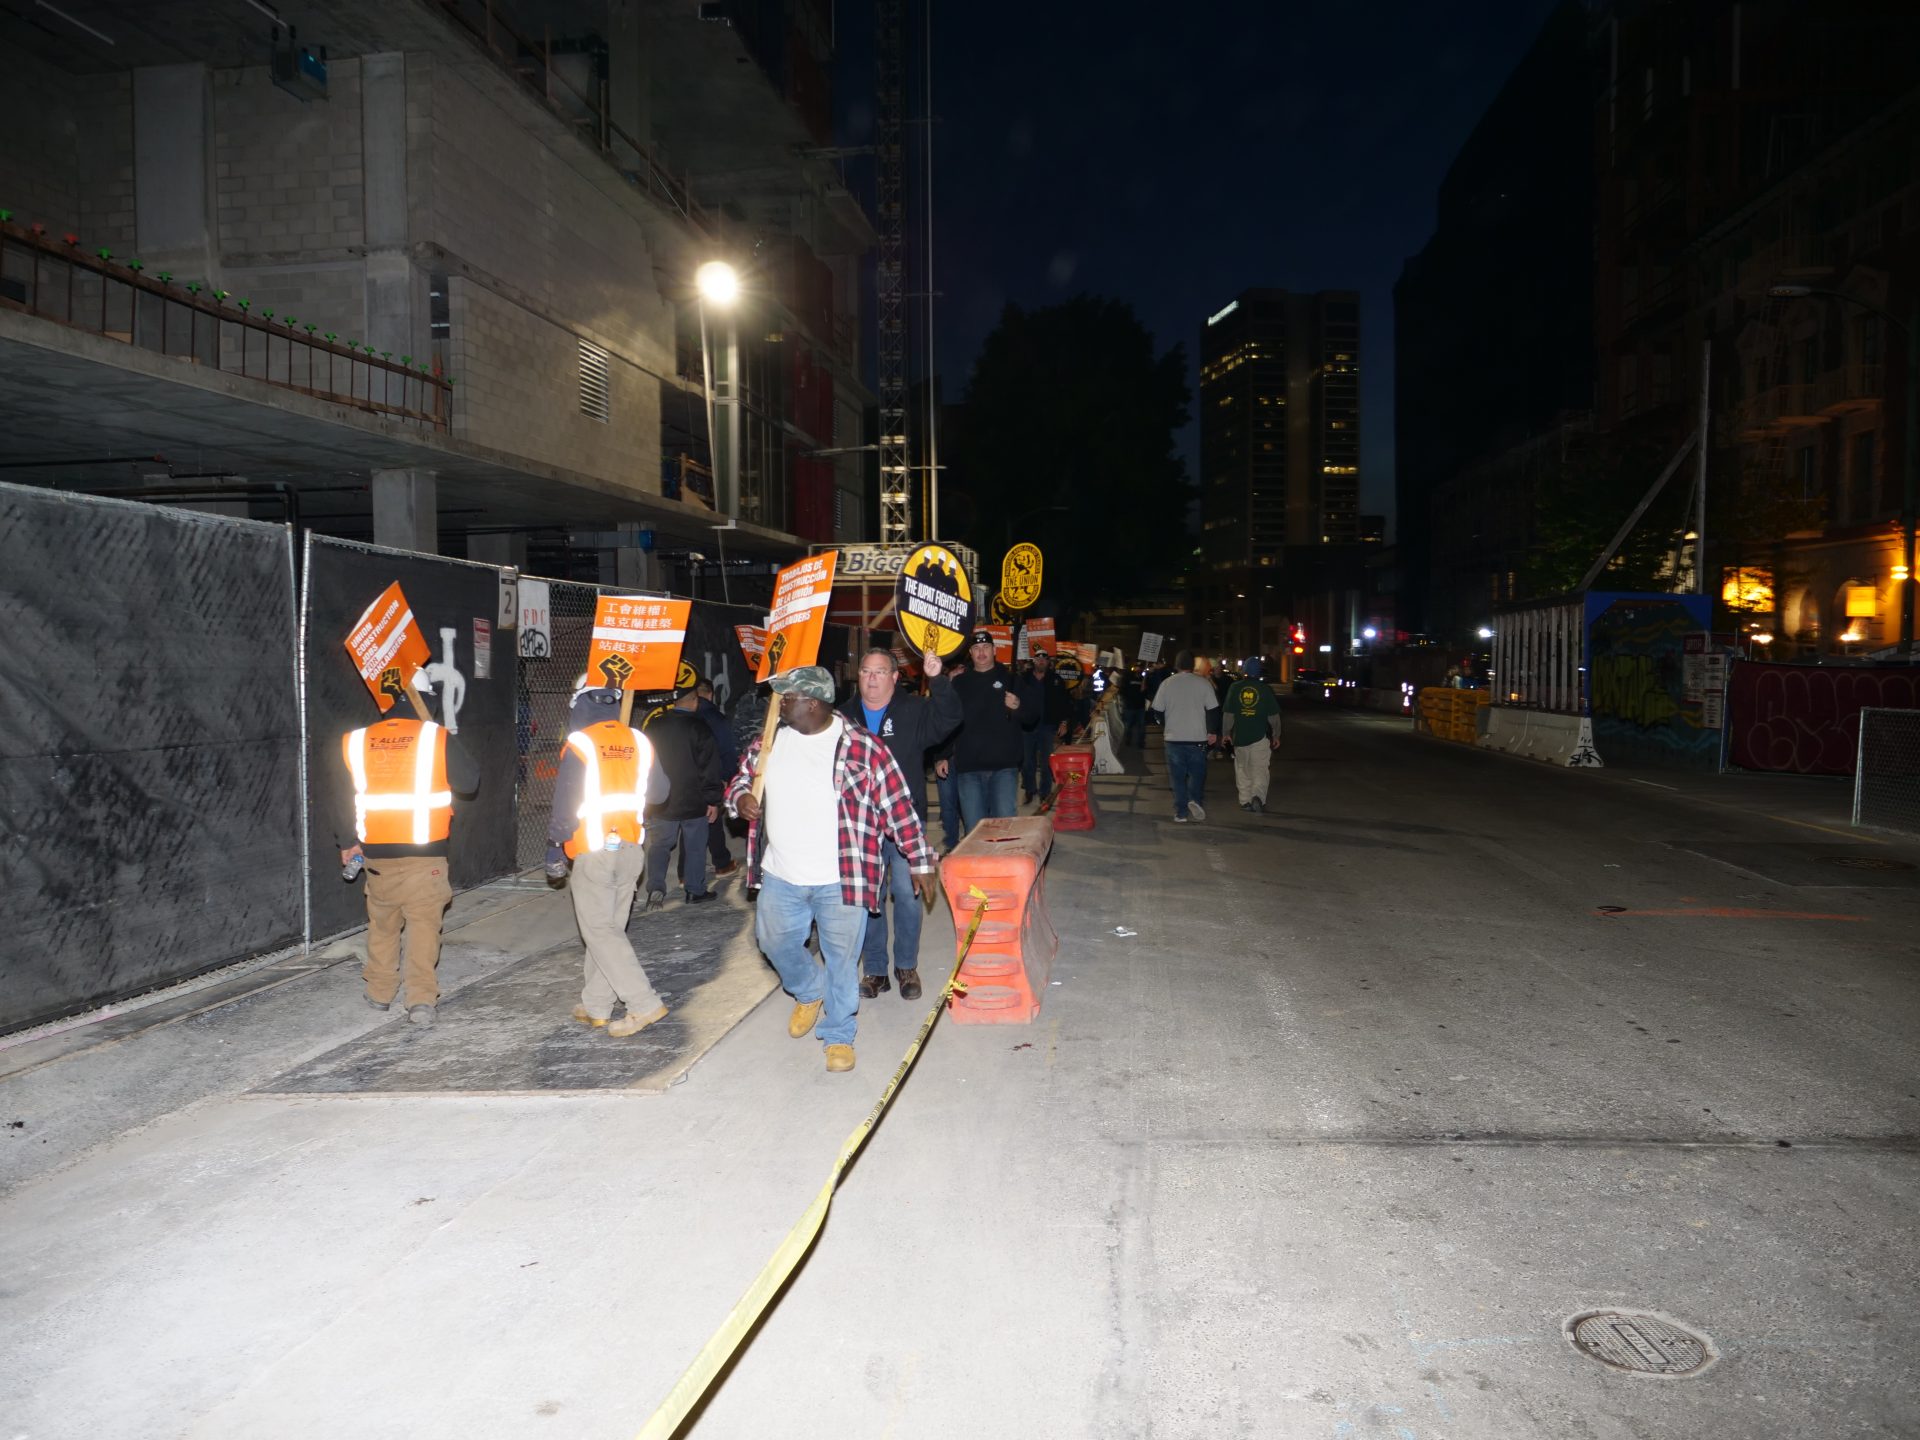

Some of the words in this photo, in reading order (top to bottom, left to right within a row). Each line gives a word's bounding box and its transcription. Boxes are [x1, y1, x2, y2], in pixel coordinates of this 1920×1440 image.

[813, 559, 824, 571] DE
[848, 552, 902, 572] BIGG
[1005, 577, 1017, 587] ONE
[1019, 575, 1039, 586] UNION
[504, 591, 512, 615] 2
[905, 576, 918, 596] THE
[917, 582, 936, 603] IUPAT
[935, 590, 956, 612] FIGHTS
[956, 599, 968, 618] FOR
[908, 596, 939, 622] WORKING
[938, 608, 961, 631] PEOPLE
[350, 622, 373, 649] UNION
[356, 600, 400, 657] CONSTRUCTION
[362, 643, 379, 666] JOBS
[366, 656, 379, 673] FOR
[369, 631, 407, 682] OAKLANDERS
[379, 736, 414, 744] ALLIED
